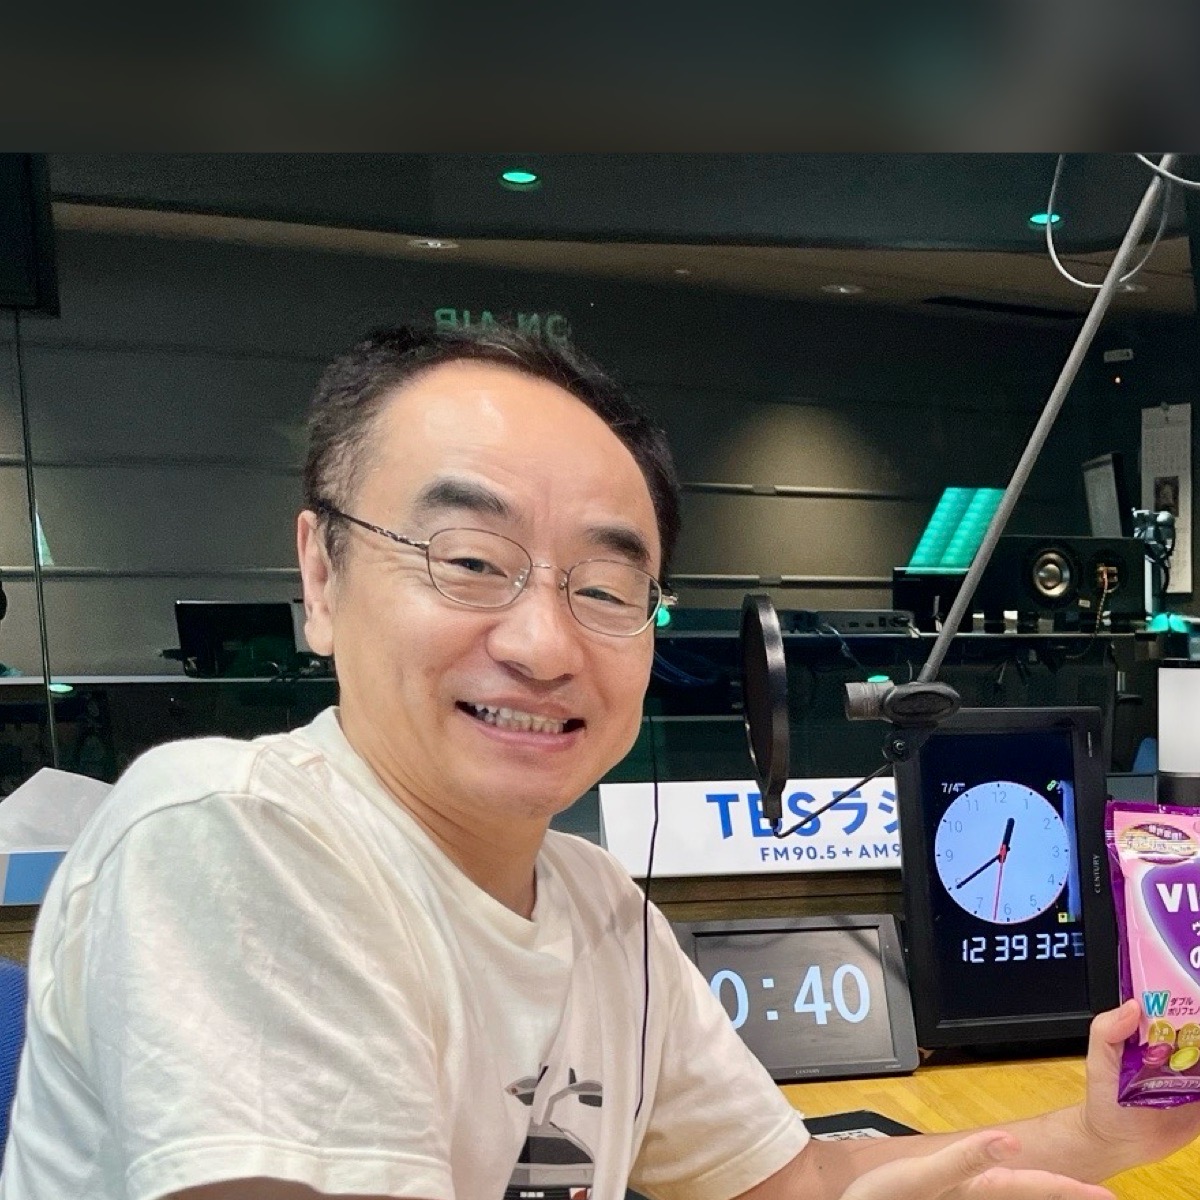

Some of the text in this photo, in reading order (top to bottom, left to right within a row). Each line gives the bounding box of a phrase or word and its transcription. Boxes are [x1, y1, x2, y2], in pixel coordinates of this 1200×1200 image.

[992, 791, 1007, 804] 12
[1023, 798, 1029, 810] 1
[967, 799, 980, 811] 11
[1043, 817, 1052, 830] 2
[945, 850, 954, 862] 9
[1052, 844, 1060, 858] 3
[1047, 873, 1055, 885] 4
[976, 896, 984, 909] 7
[1029, 894, 1038, 907] 5
[1003, 903, 1012, 915] 6
[962, 936, 987, 964] 12
[995, 934, 1029, 962] 39
[1035, 932, 1069, 960] 32
[1142, 990, 1171, 1018] W
